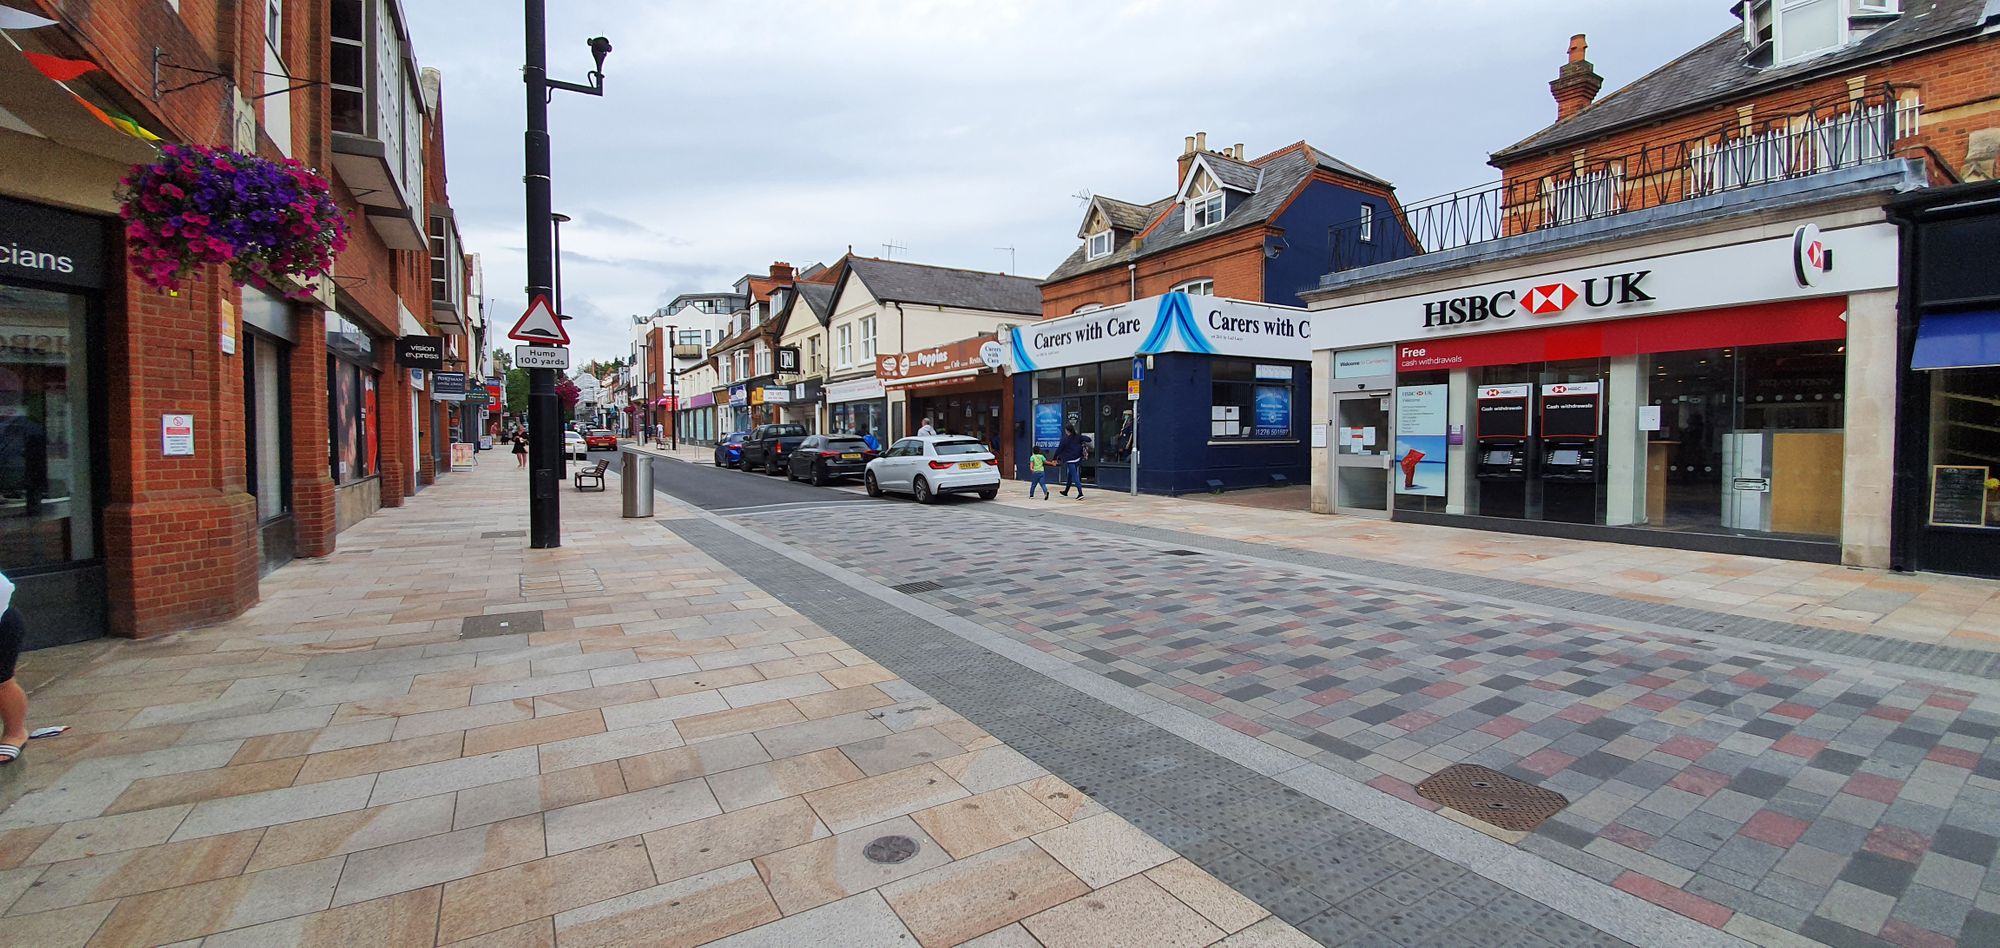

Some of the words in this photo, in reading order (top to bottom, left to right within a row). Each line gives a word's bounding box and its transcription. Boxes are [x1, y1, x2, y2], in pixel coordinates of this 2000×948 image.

[1422, 289, 1516, 328] HSBC
[1581, 270, 1656, 307] UK
[1208, 309, 1260, 334] Carers
[1264, 317, 1294, 337] with
[1299, 320, 1311, 339] C
[1034, 331, 1072, 350] Carers
[1076, 321, 1102, 343] with
[1107, 317, 1141, 337] Care
[410, 343, 435, 352] vision
[1401, 347, 1426, 358] Free
[405, 352, 440, 360] express
[530, 349, 556, 358] Hump
[917, 348, 948, 368] Poppins
[540, 358, 565, 366] yards
[1401, 358, 1417, 367] cash
[1418, 355, 1462, 366] withdrawals
[1077, 378, 1084, 387] 27
